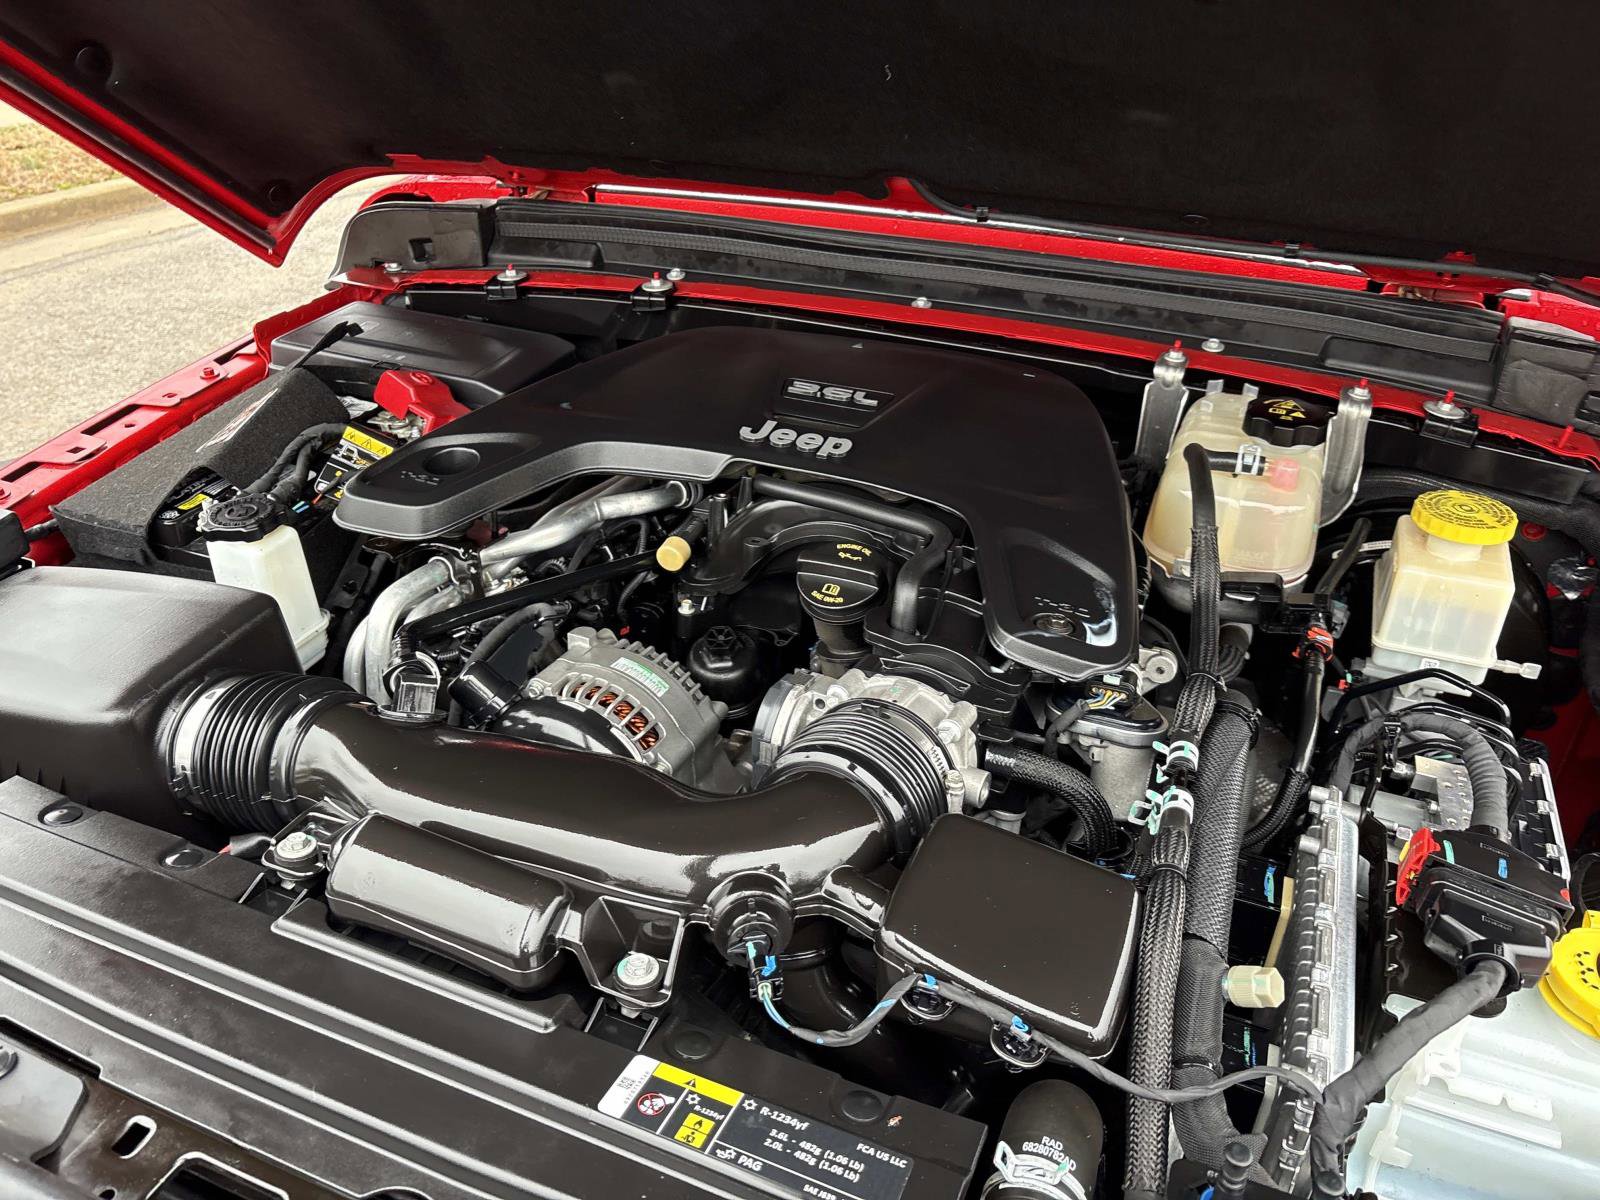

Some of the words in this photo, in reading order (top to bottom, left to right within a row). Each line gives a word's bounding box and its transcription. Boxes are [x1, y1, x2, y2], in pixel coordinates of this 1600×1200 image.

[787, 380, 879, 407] 3.6L
[739, 419, 853, 459] Jeep
[759, 1106, 811, 1131] R-1234yf
[769, 1128, 789, 1142] 3.6L
[798, 1140, 822, 1156] 482g
[824, 1149, 848, 1166] (1.06
[856, 1143, 875, 1156] FCA
[875, 1150, 890, 1162] US
[889, 1155, 908, 1169] LLC
[1041, 1135, 1064, 1151] RAD
[738, 1154, 764, 1172] PAG
[763, 1138, 783, 1152] 2.0L
[793, 1150, 818, 1166] 482g
[818, 1160, 843, 1176] (1.06
[803, 1184, 819, 1195] SAE
